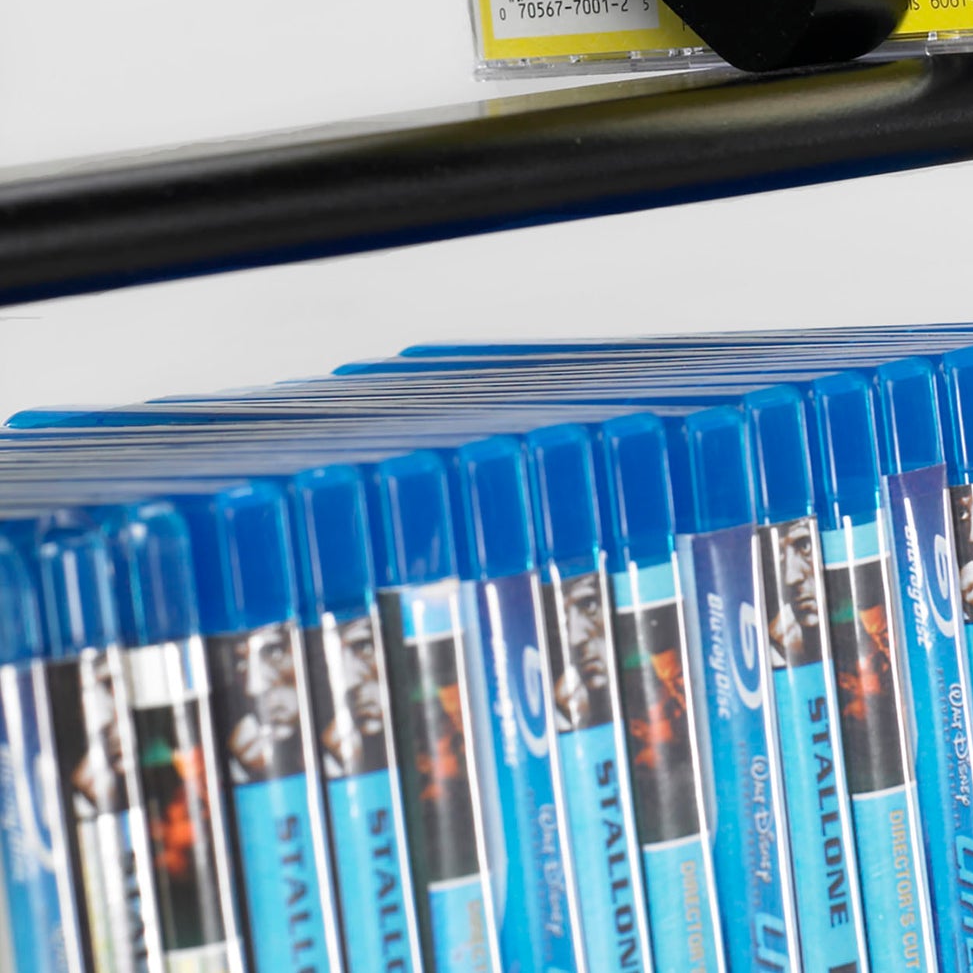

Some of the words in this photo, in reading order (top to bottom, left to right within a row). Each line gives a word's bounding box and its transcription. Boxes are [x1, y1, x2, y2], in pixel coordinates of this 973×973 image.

[499, 7, 507, 21] 0
[714, 672, 732, 720] Disc
[954, 733, 970, 807] Disney
[807, 696, 850, 928] STALLONE
[889, 809, 915, 927] DIRECTOR'S
[902, 932, 921, 969] CUT
